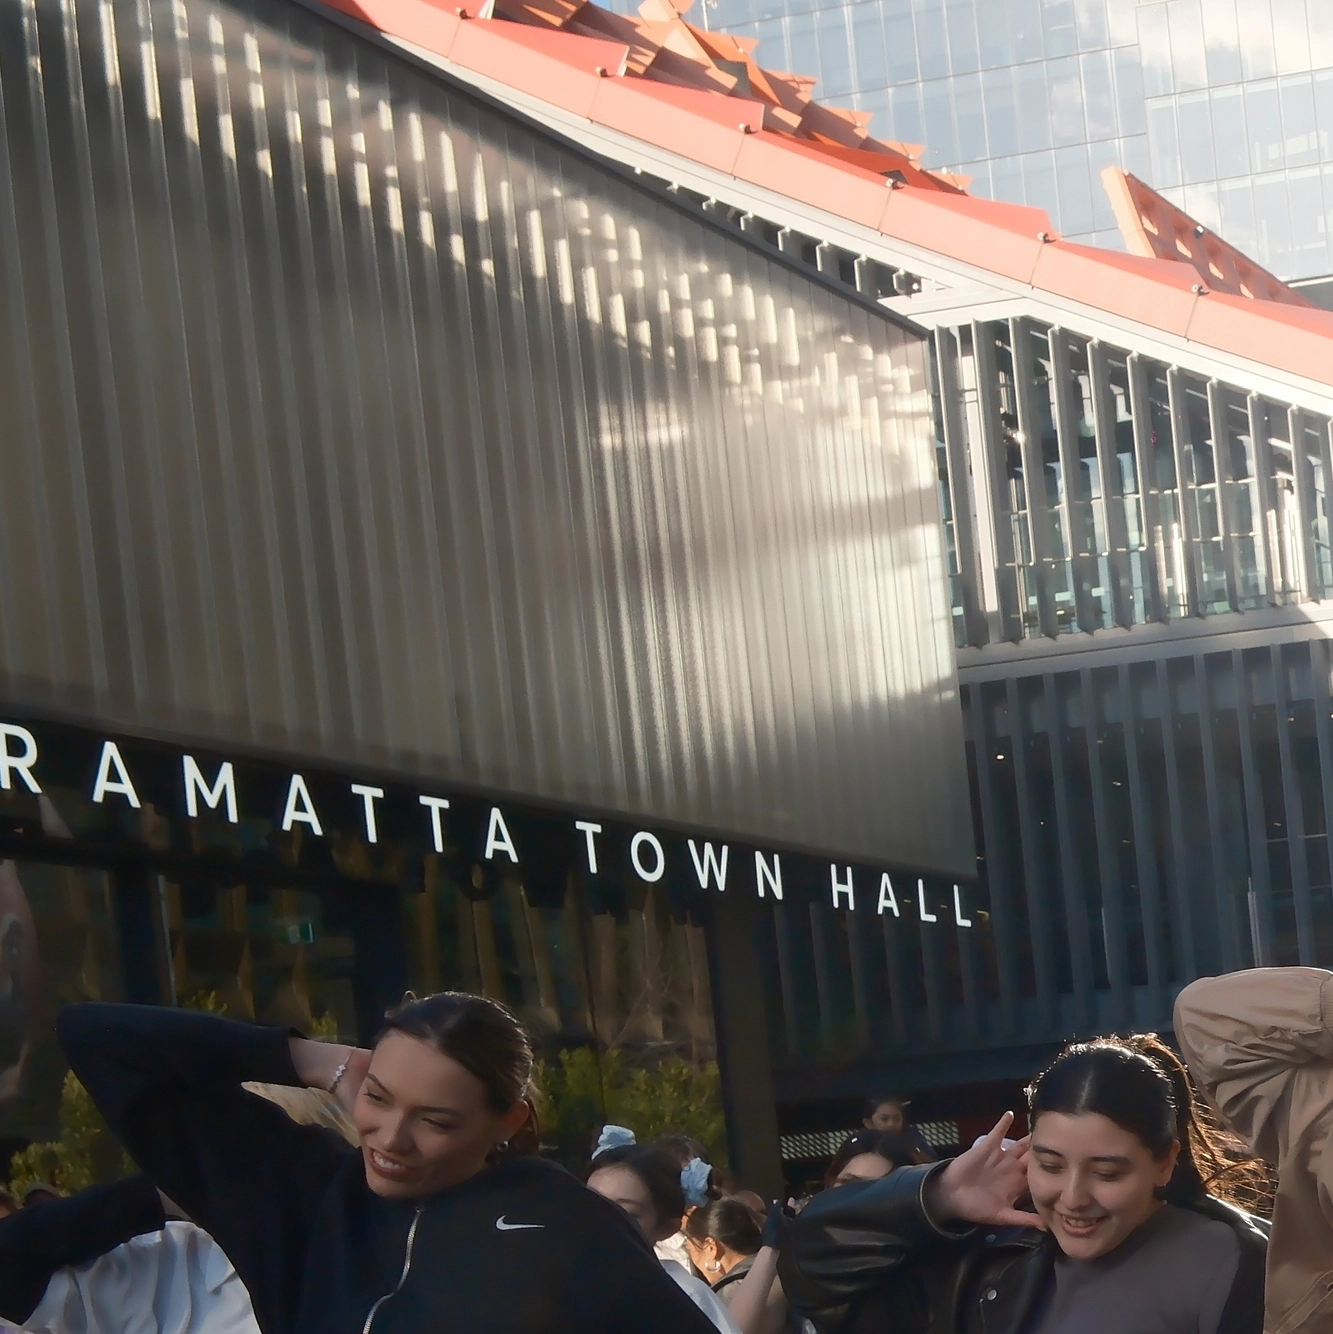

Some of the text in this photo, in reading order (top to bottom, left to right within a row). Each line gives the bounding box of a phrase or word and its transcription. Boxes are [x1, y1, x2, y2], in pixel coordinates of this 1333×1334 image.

[0, 722, 972, 928] RAMATTA TOWN HALL
